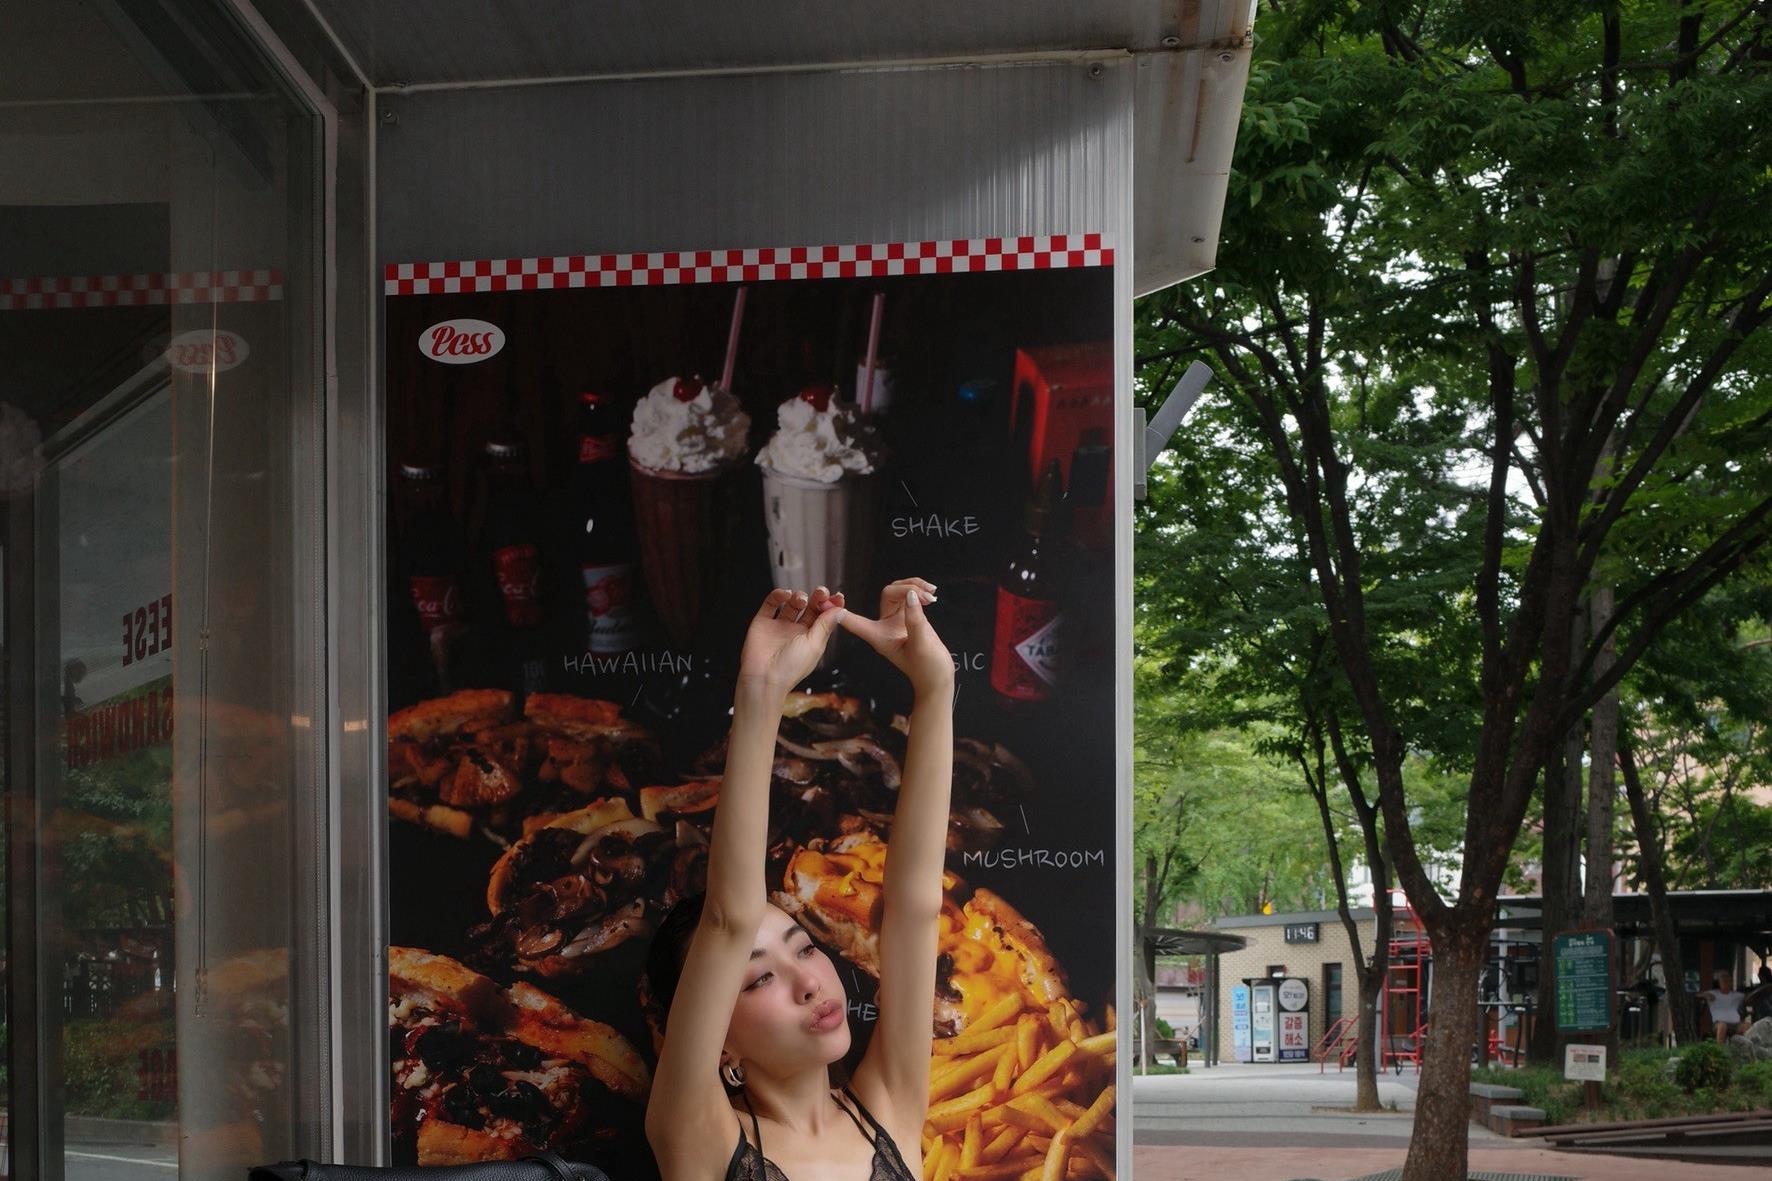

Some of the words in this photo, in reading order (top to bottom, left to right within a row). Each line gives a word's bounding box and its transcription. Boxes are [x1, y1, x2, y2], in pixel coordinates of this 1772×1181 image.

[431, 325, 495, 357] Pess
[892, 515, 980, 538] SHAKE
[564, 650, 693, 677] HAWAIIAN
[963, 847, 1106, 870] MUSHROOM
[847, 998, 879, 1022] HE
